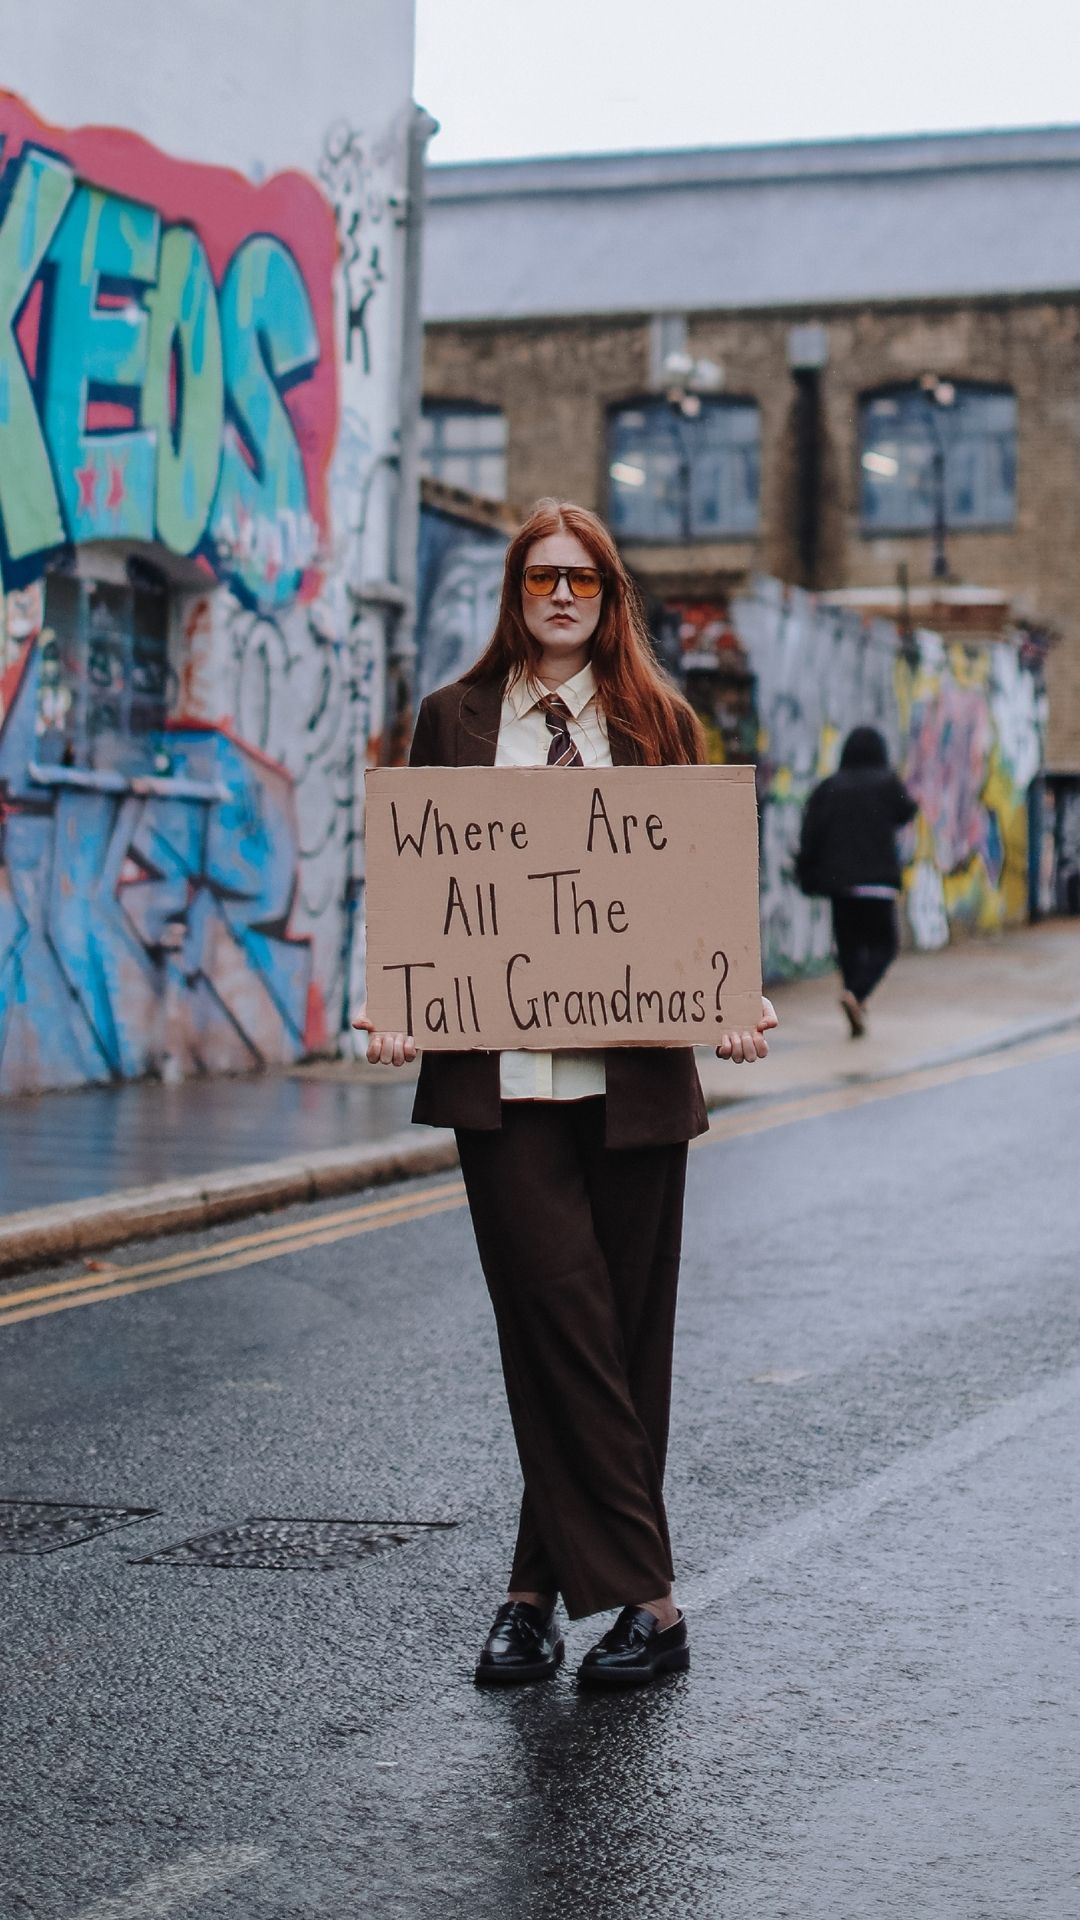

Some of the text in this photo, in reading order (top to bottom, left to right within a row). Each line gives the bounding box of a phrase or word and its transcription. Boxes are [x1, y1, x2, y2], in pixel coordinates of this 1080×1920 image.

[391, 788, 667, 858] Where Are
[444, 869, 628, 936] All The
[383, 951, 728, 1036] Tall Grandmas?
